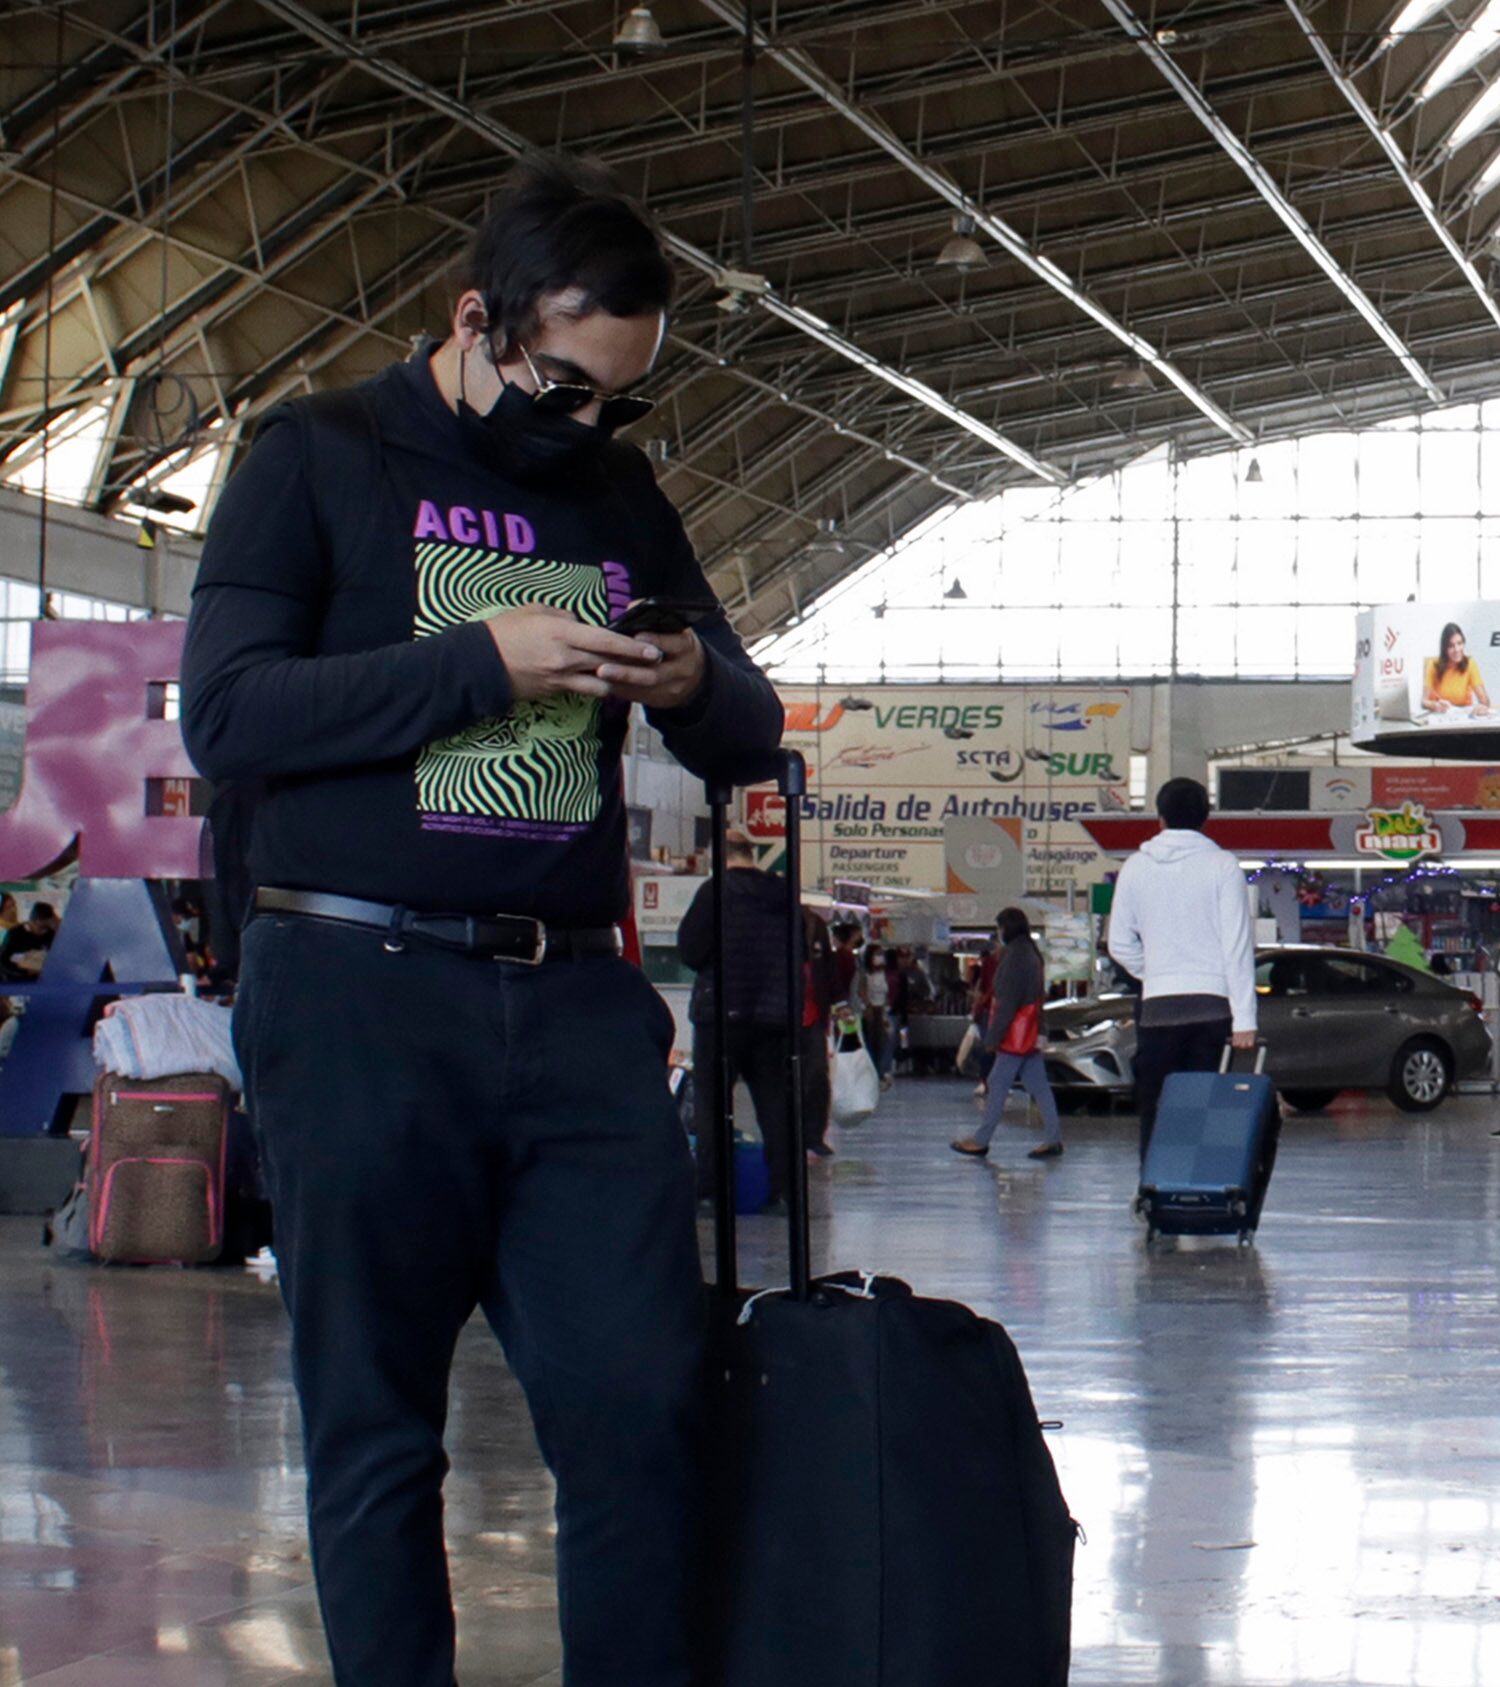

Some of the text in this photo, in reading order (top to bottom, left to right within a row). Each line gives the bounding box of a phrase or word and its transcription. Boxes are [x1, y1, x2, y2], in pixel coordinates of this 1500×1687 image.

[413, 499, 536, 553] ACID
[872, 705, 1004, 729] VERDES
[1045, 751, 1115, 777] SUR
[800, 793, 887, 821] Salida
[896, 793, 932, 822] de
[833, 822, 868, 837] Solo
[1363, 833, 1431, 850] mart
[830, 845, 908, 862] Departure
[832, 862, 900, 872] PASSENGERS
